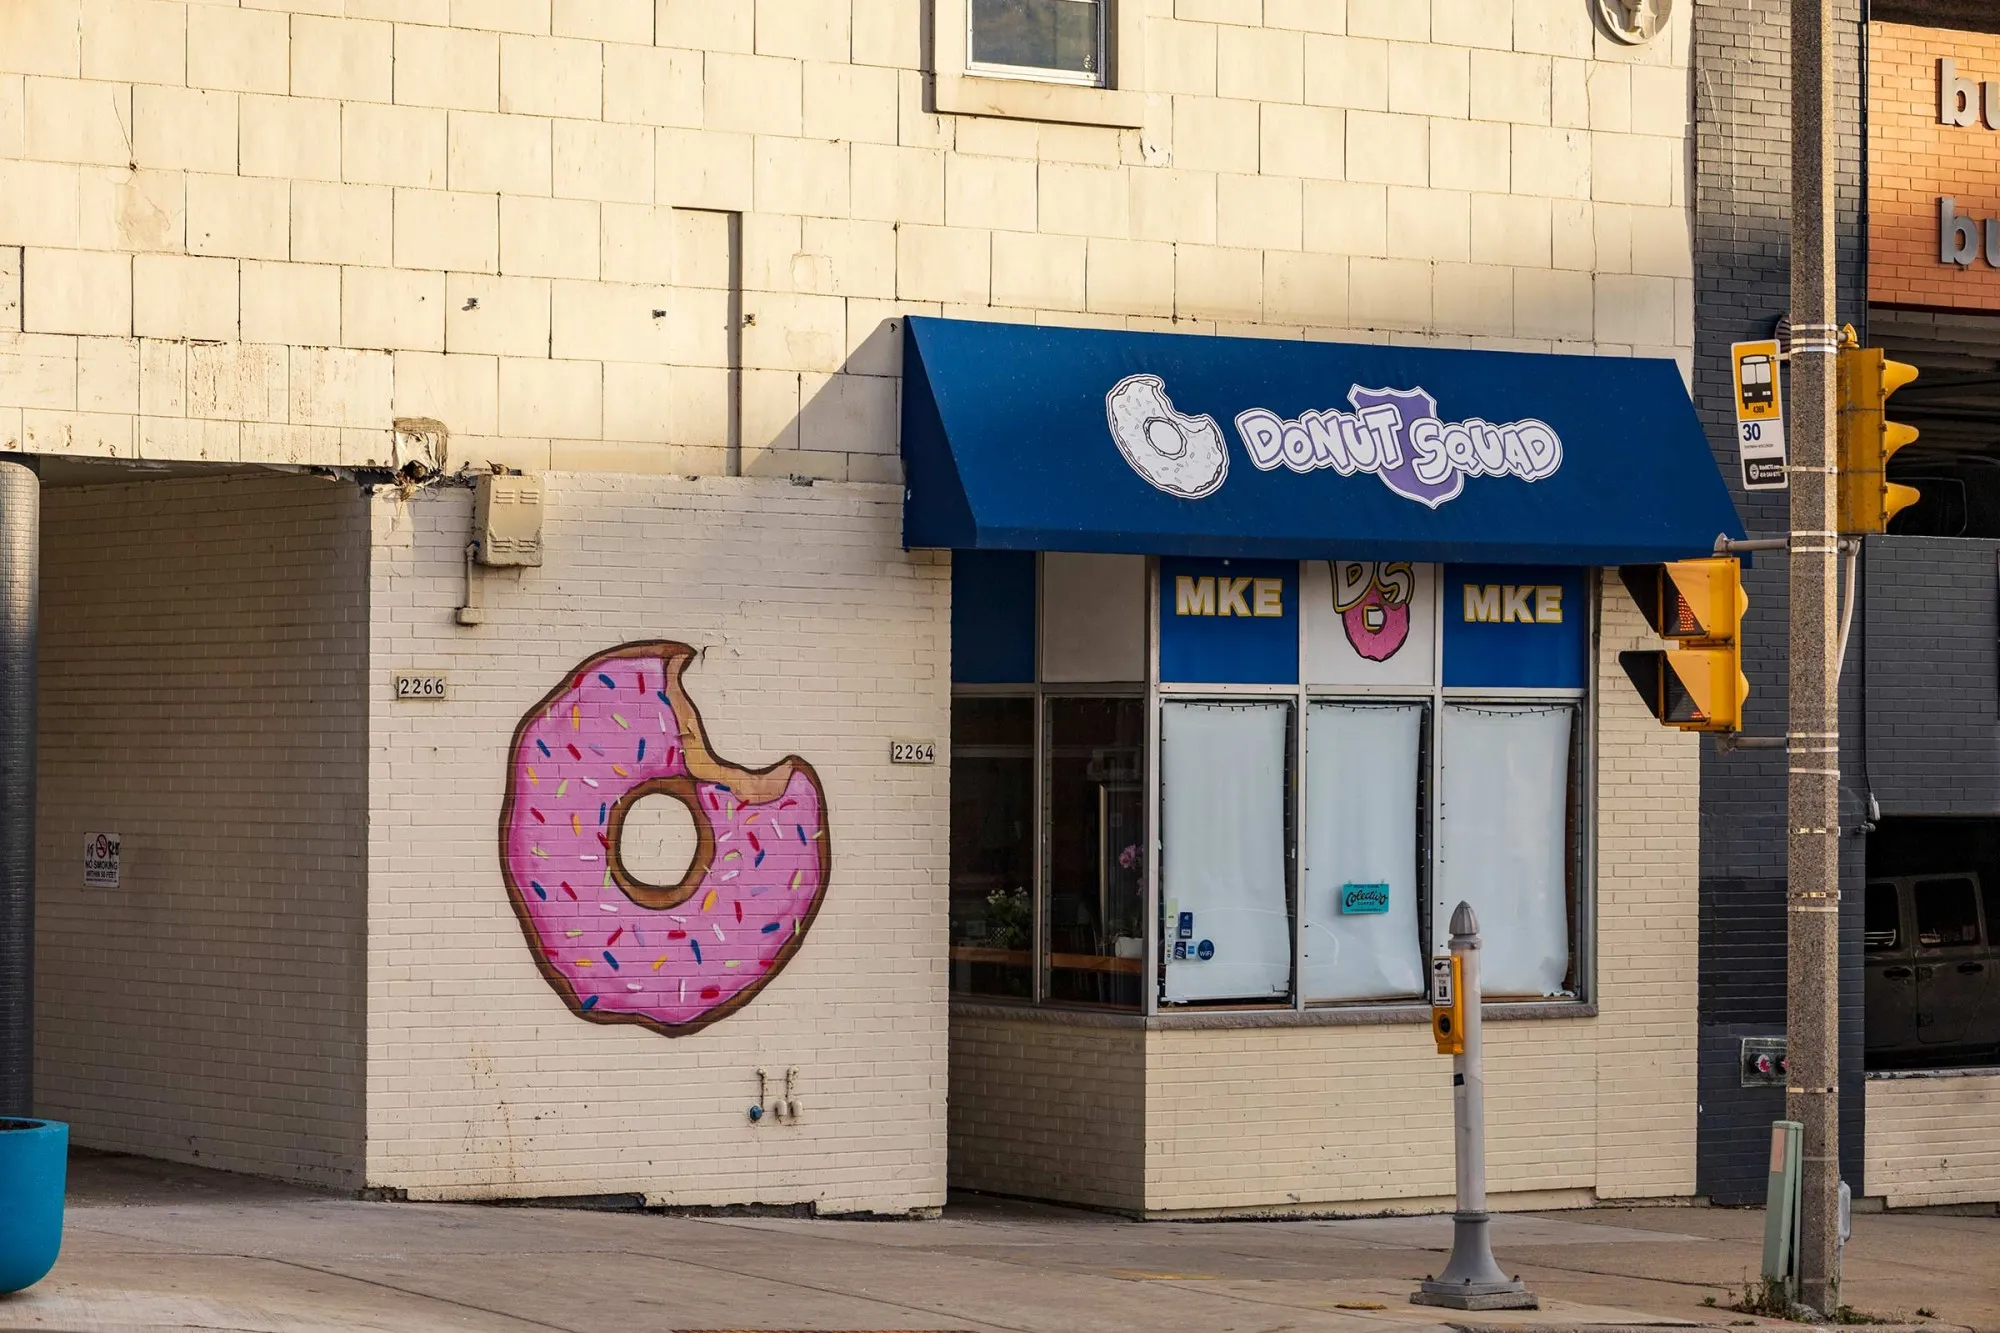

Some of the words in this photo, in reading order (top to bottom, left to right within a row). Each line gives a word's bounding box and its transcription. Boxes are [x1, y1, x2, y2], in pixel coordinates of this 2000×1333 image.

[1743, 423, 1761, 441] 30
[1409, 417, 1563, 485] SQUAD
[1175, 575, 1283, 617] MKE
[1463, 584, 1562, 623] MKE
[400, 678, 444, 695] 2266
[895, 744, 934, 760] 2264
[85, 860, 93, 869] NO
